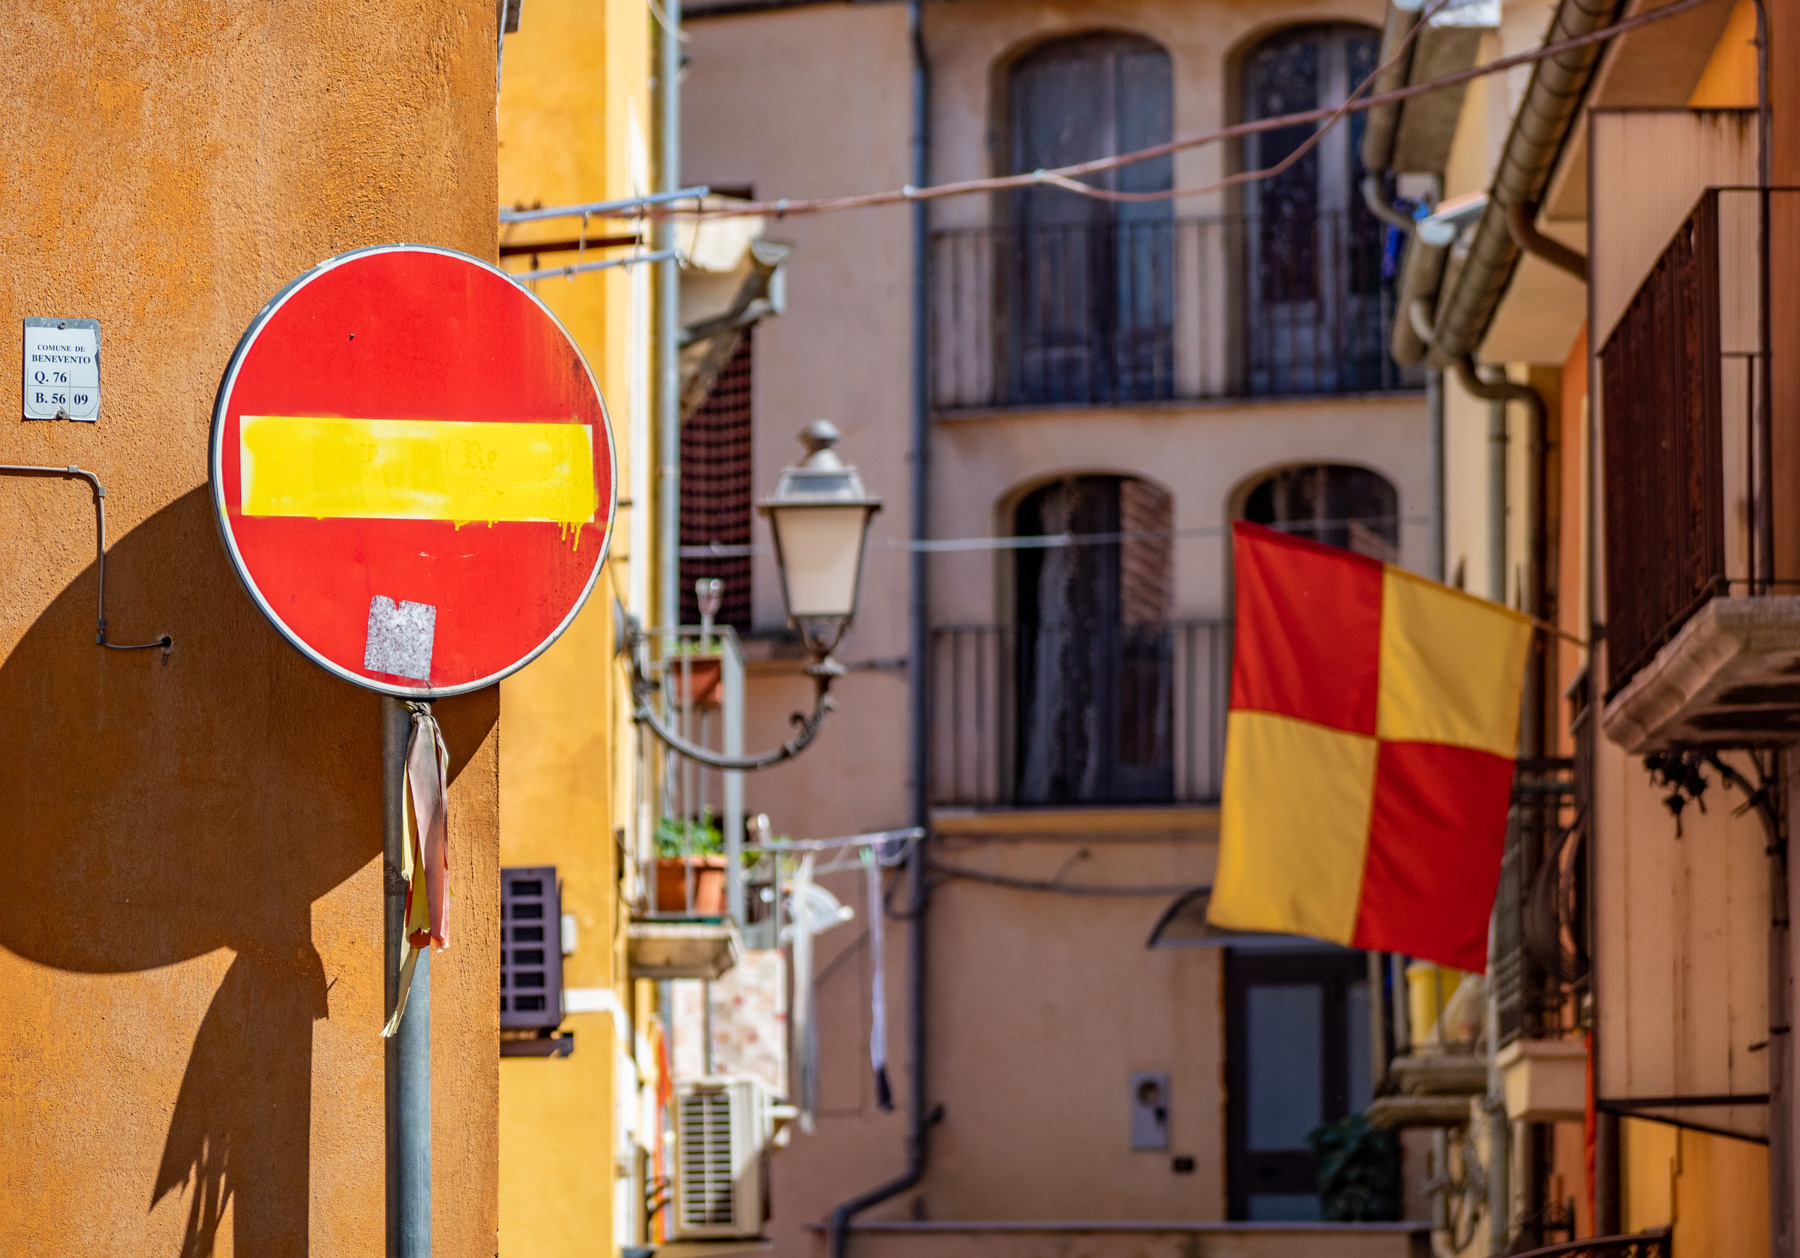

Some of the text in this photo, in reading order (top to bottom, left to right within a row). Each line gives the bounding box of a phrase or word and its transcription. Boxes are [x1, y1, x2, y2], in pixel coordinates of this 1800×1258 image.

[37, 344, 71, 352] COMUNE
[32, 354, 91, 364] BENEVENTO
[34, 371, 67, 384] Q. 76
[35, 392, 66, 404] B. 56
[74, 394, 88, 405] 09
